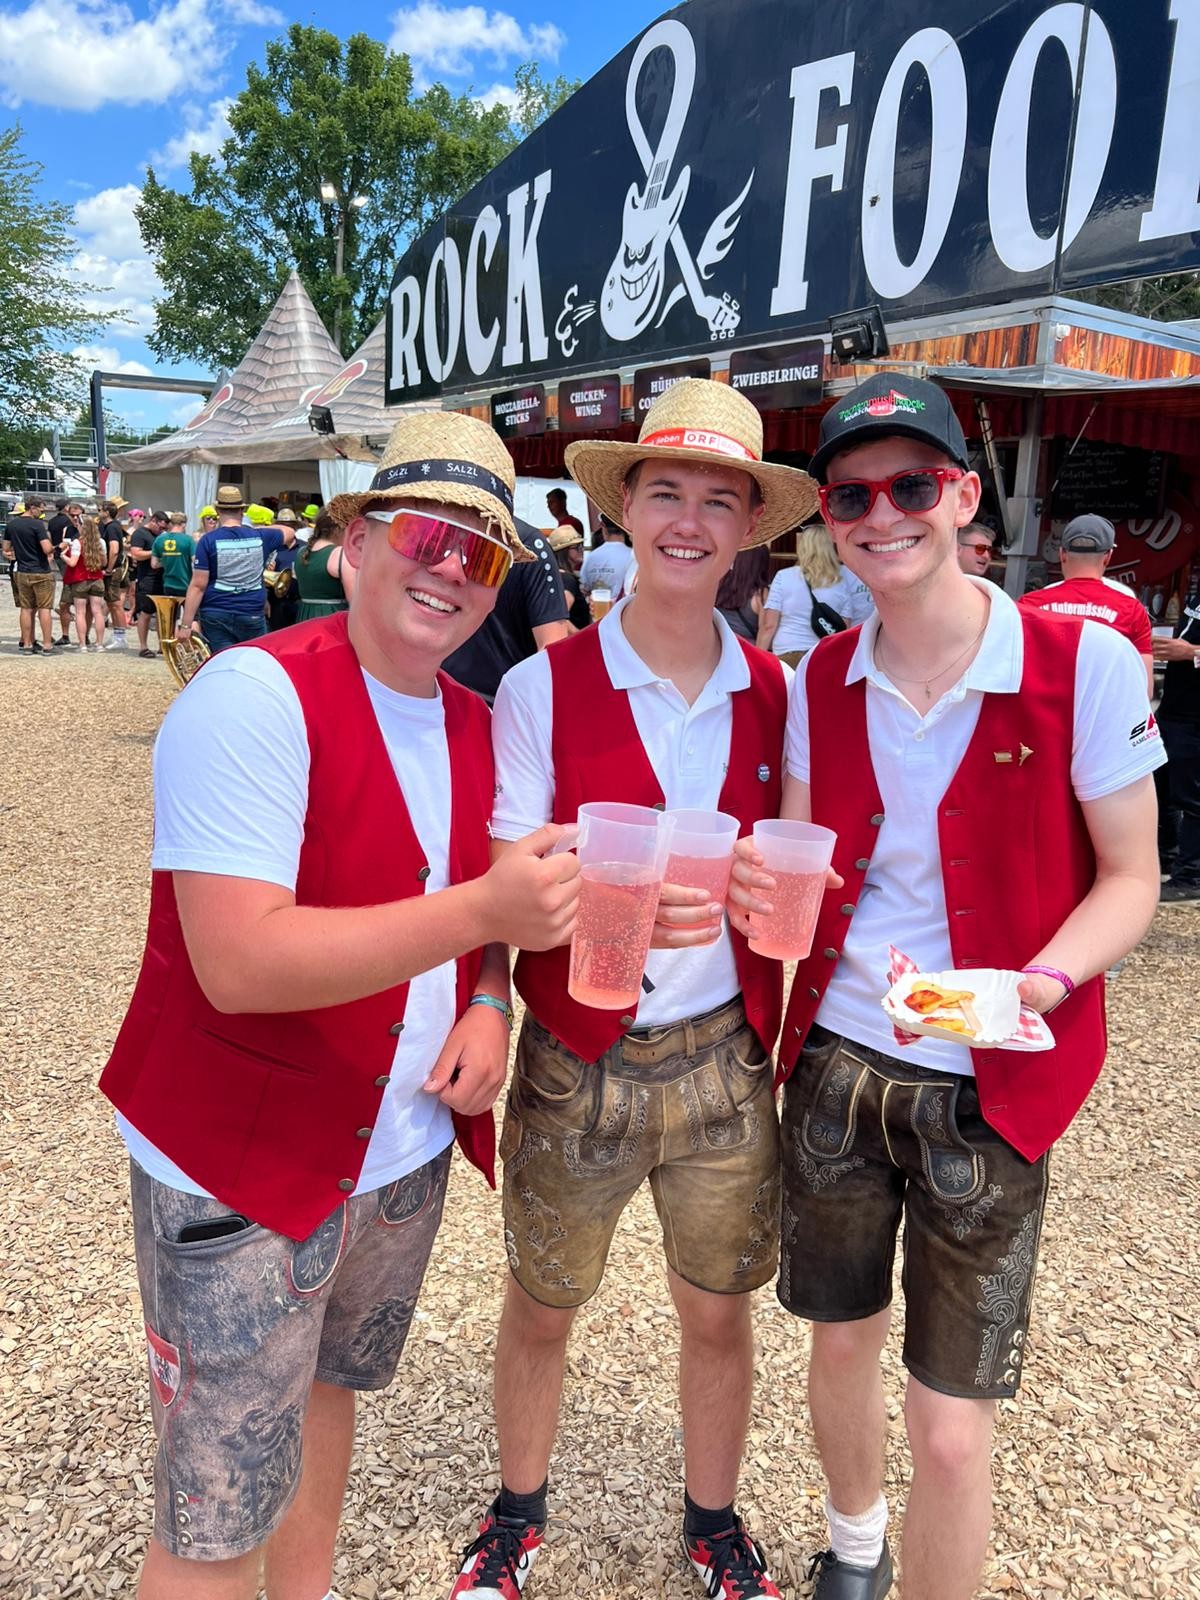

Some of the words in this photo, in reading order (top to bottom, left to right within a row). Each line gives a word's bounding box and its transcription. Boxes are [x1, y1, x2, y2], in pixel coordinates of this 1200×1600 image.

[389, 168, 552, 390] ROCK
[732, 364, 819, 388] ZWIEBELRINGE
[570, 389, 607, 404] CHICKEN-
[494, 396, 541, 415] MOZZARELLA-
[574, 404, 602, 417] WINGS
[505, 412, 530, 426] STICKS
[686, 433, 717, 445] ORF
[387, 467, 408, 479] SALZL
[447, 462, 478, 476] SALZL
[1051, 602, 1118, 623] Untermässing
